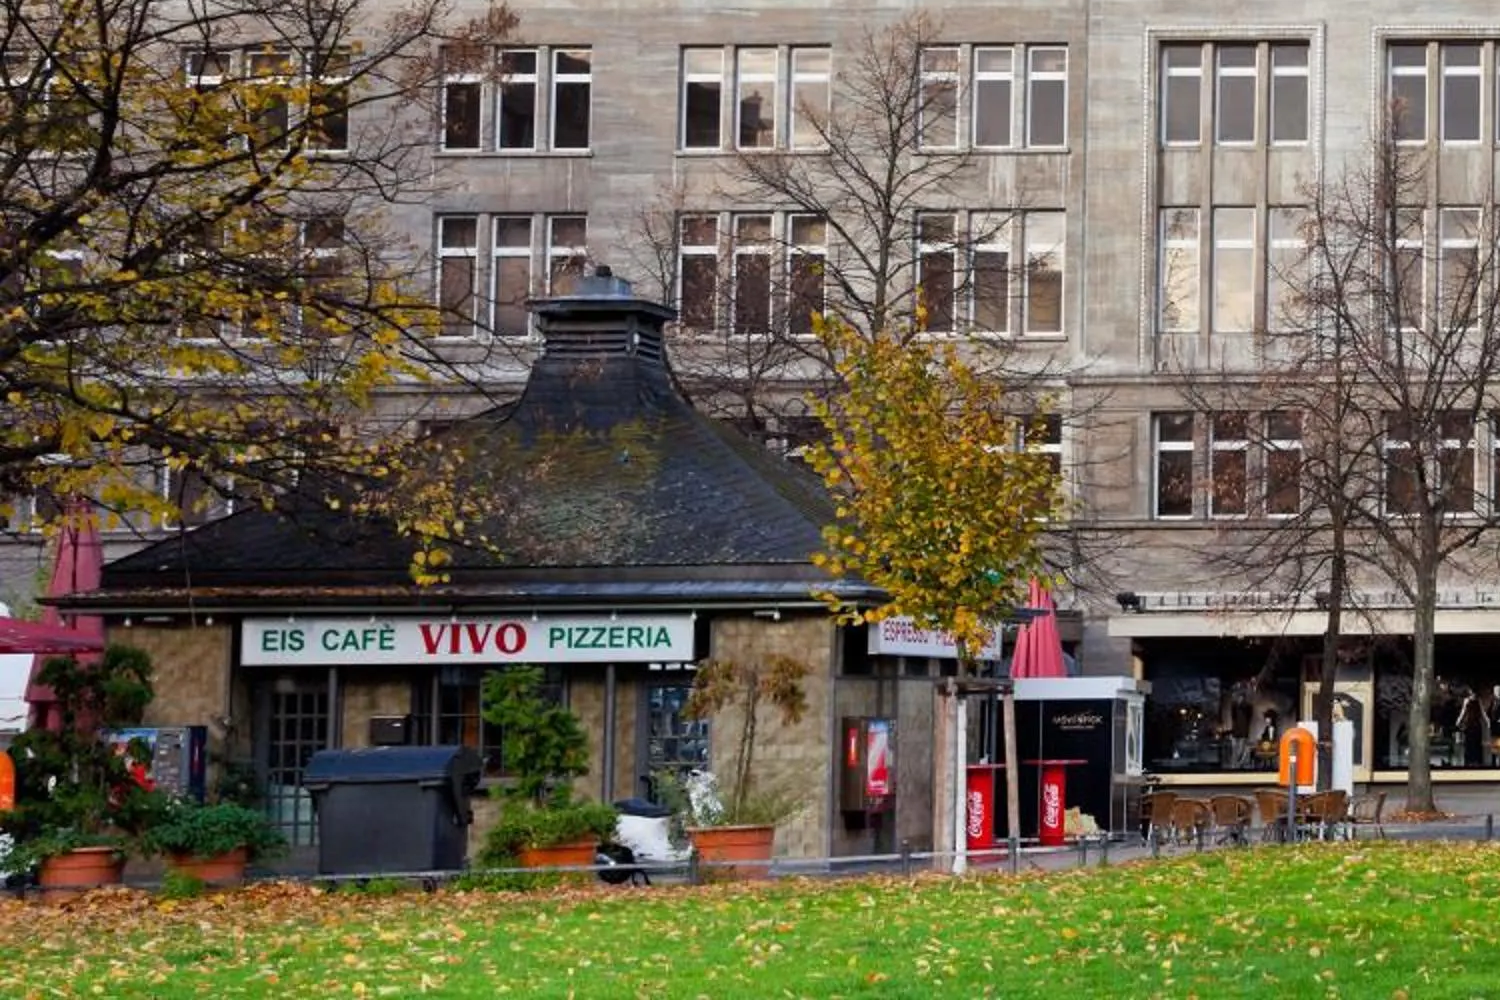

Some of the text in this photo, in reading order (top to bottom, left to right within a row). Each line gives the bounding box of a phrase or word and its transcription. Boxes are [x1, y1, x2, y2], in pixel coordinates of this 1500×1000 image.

[262, 629, 305, 652] EIS
[418, 622, 527, 655] VIVO
[549, 626, 672, 649] PIZZERIA
[1043, 782, 1060, 829] Coca-Cola
